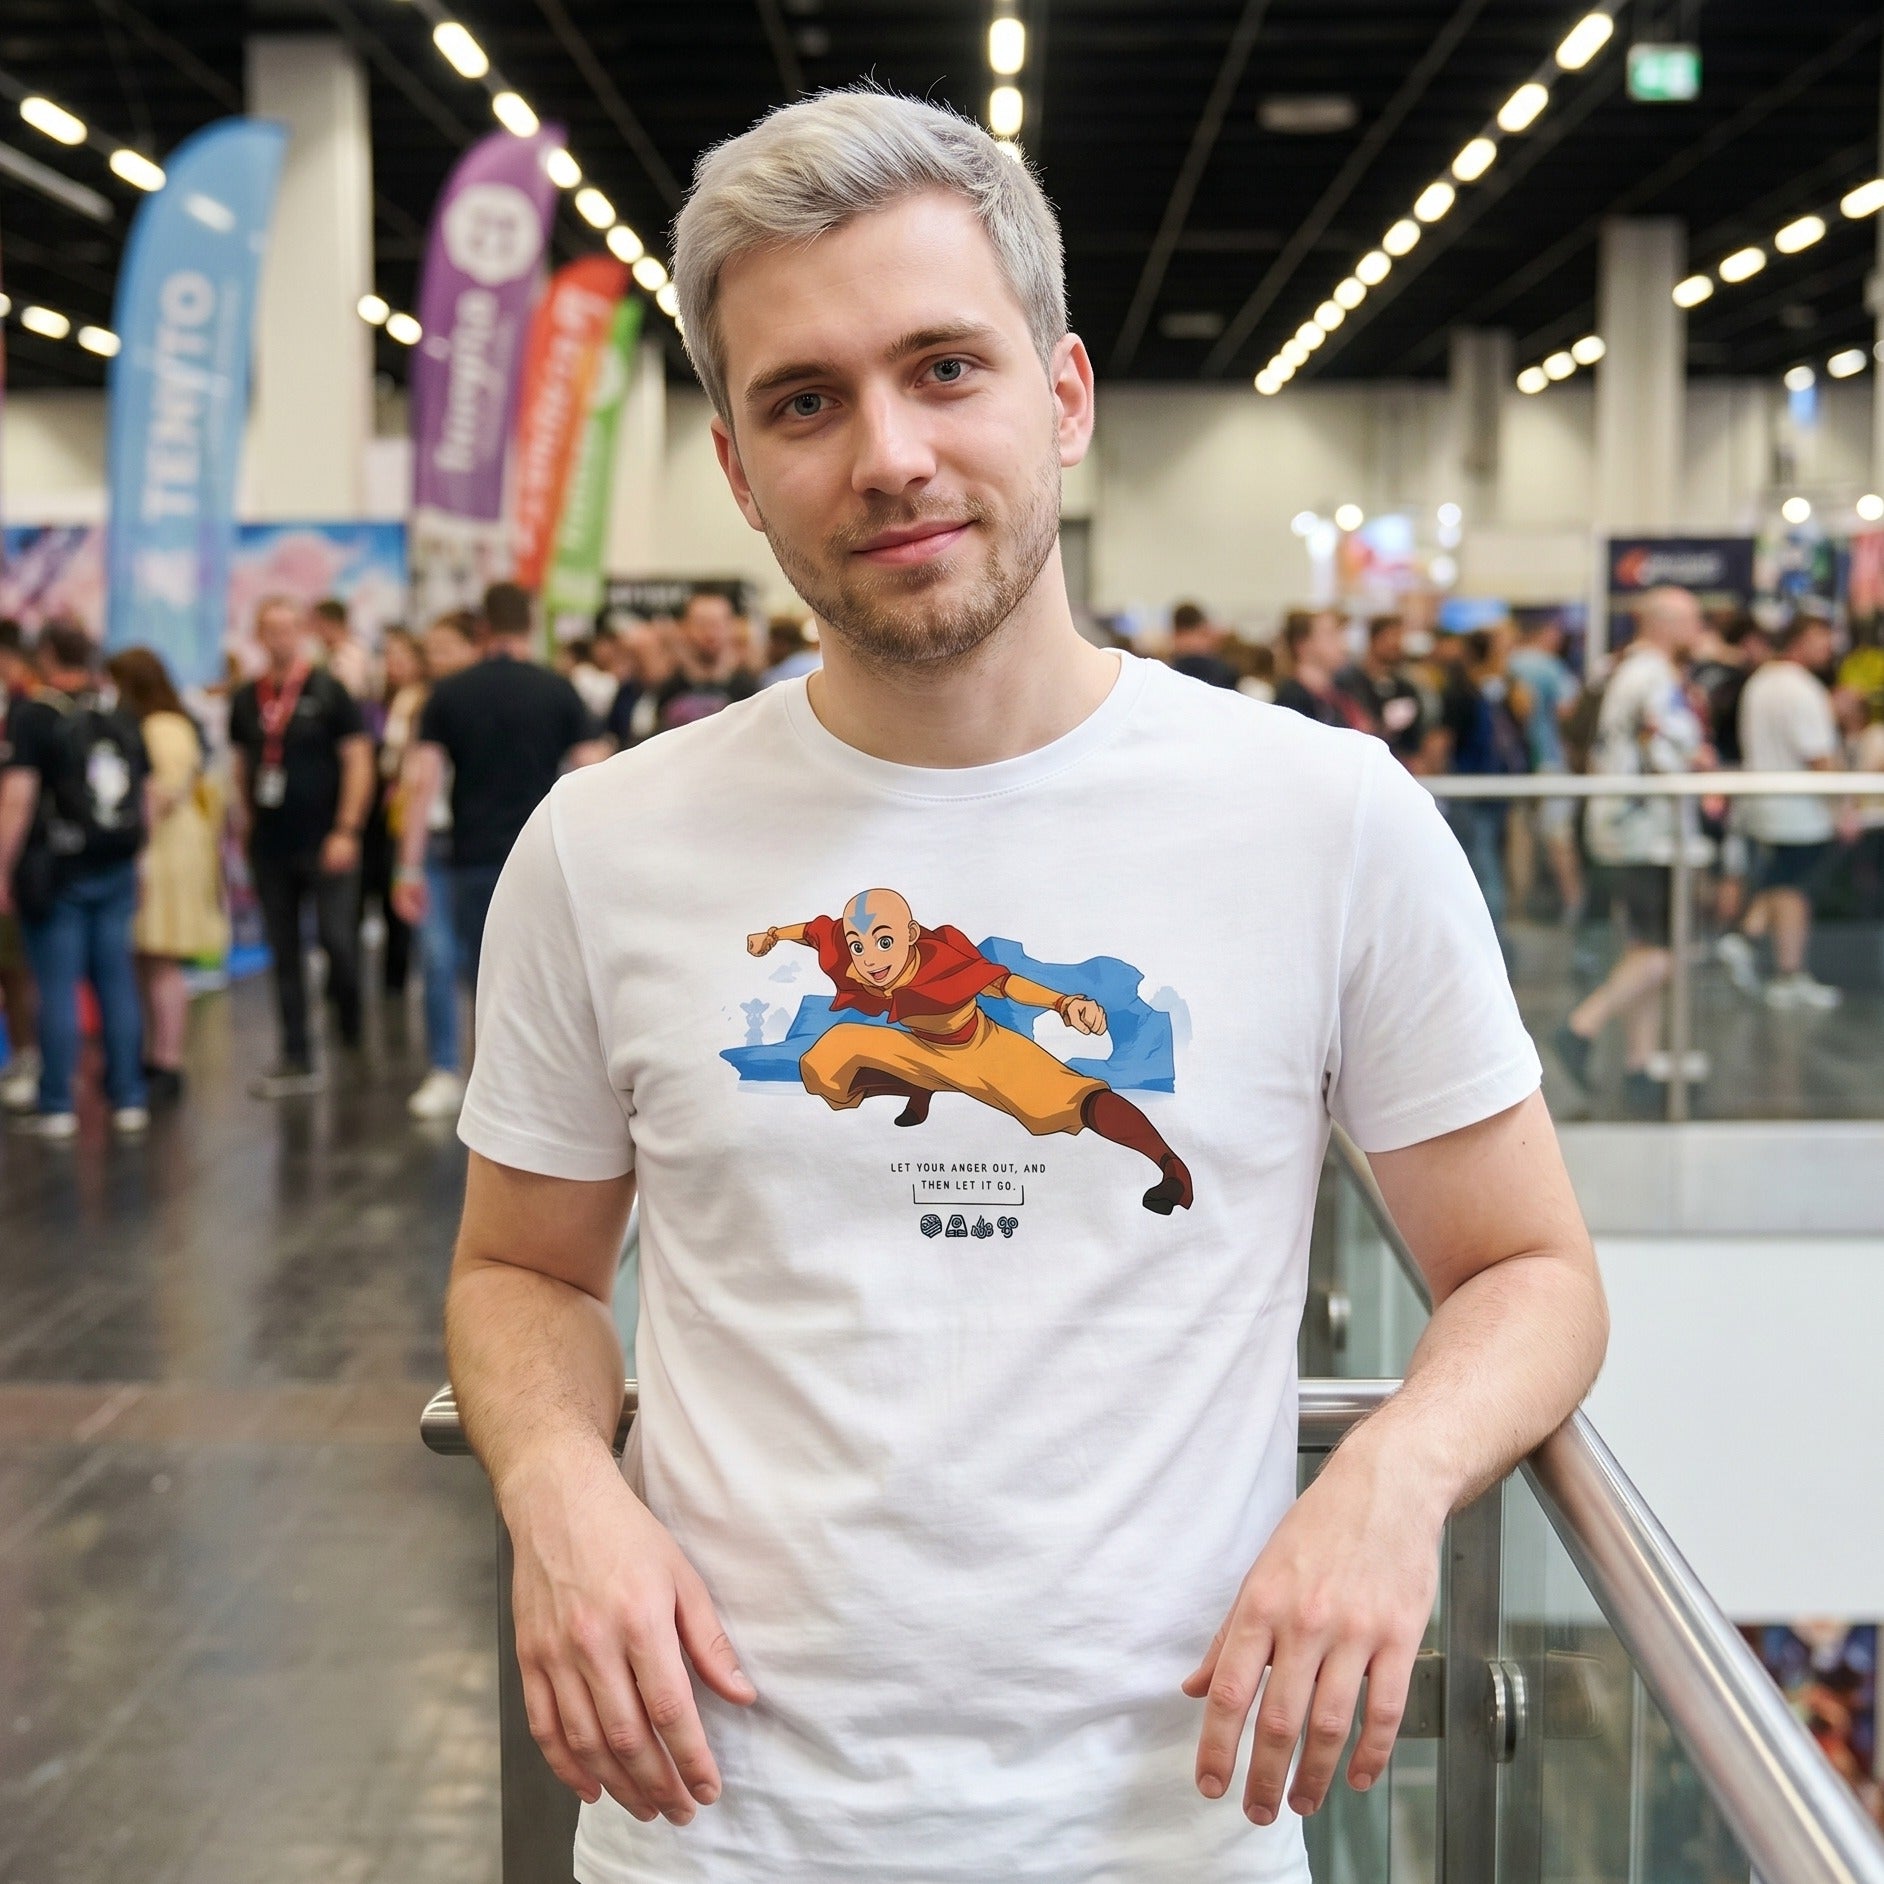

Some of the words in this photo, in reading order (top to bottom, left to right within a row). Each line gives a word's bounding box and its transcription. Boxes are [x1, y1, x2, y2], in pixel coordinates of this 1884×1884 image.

[890, 1162, 911, 1173] LET
[916, 1162, 946, 1173] YOUR
[950, 1162, 988, 1173] ANGER
[992, 1163, 1018, 1175] OUT,
[1023, 1163, 1046, 1174] AND
[921, 1179, 950, 1190] THEN
[955, 1180, 976, 1190] LET
[981, 1180, 992, 1190] IT
[997, 1180, 1016, 1191] GO.
